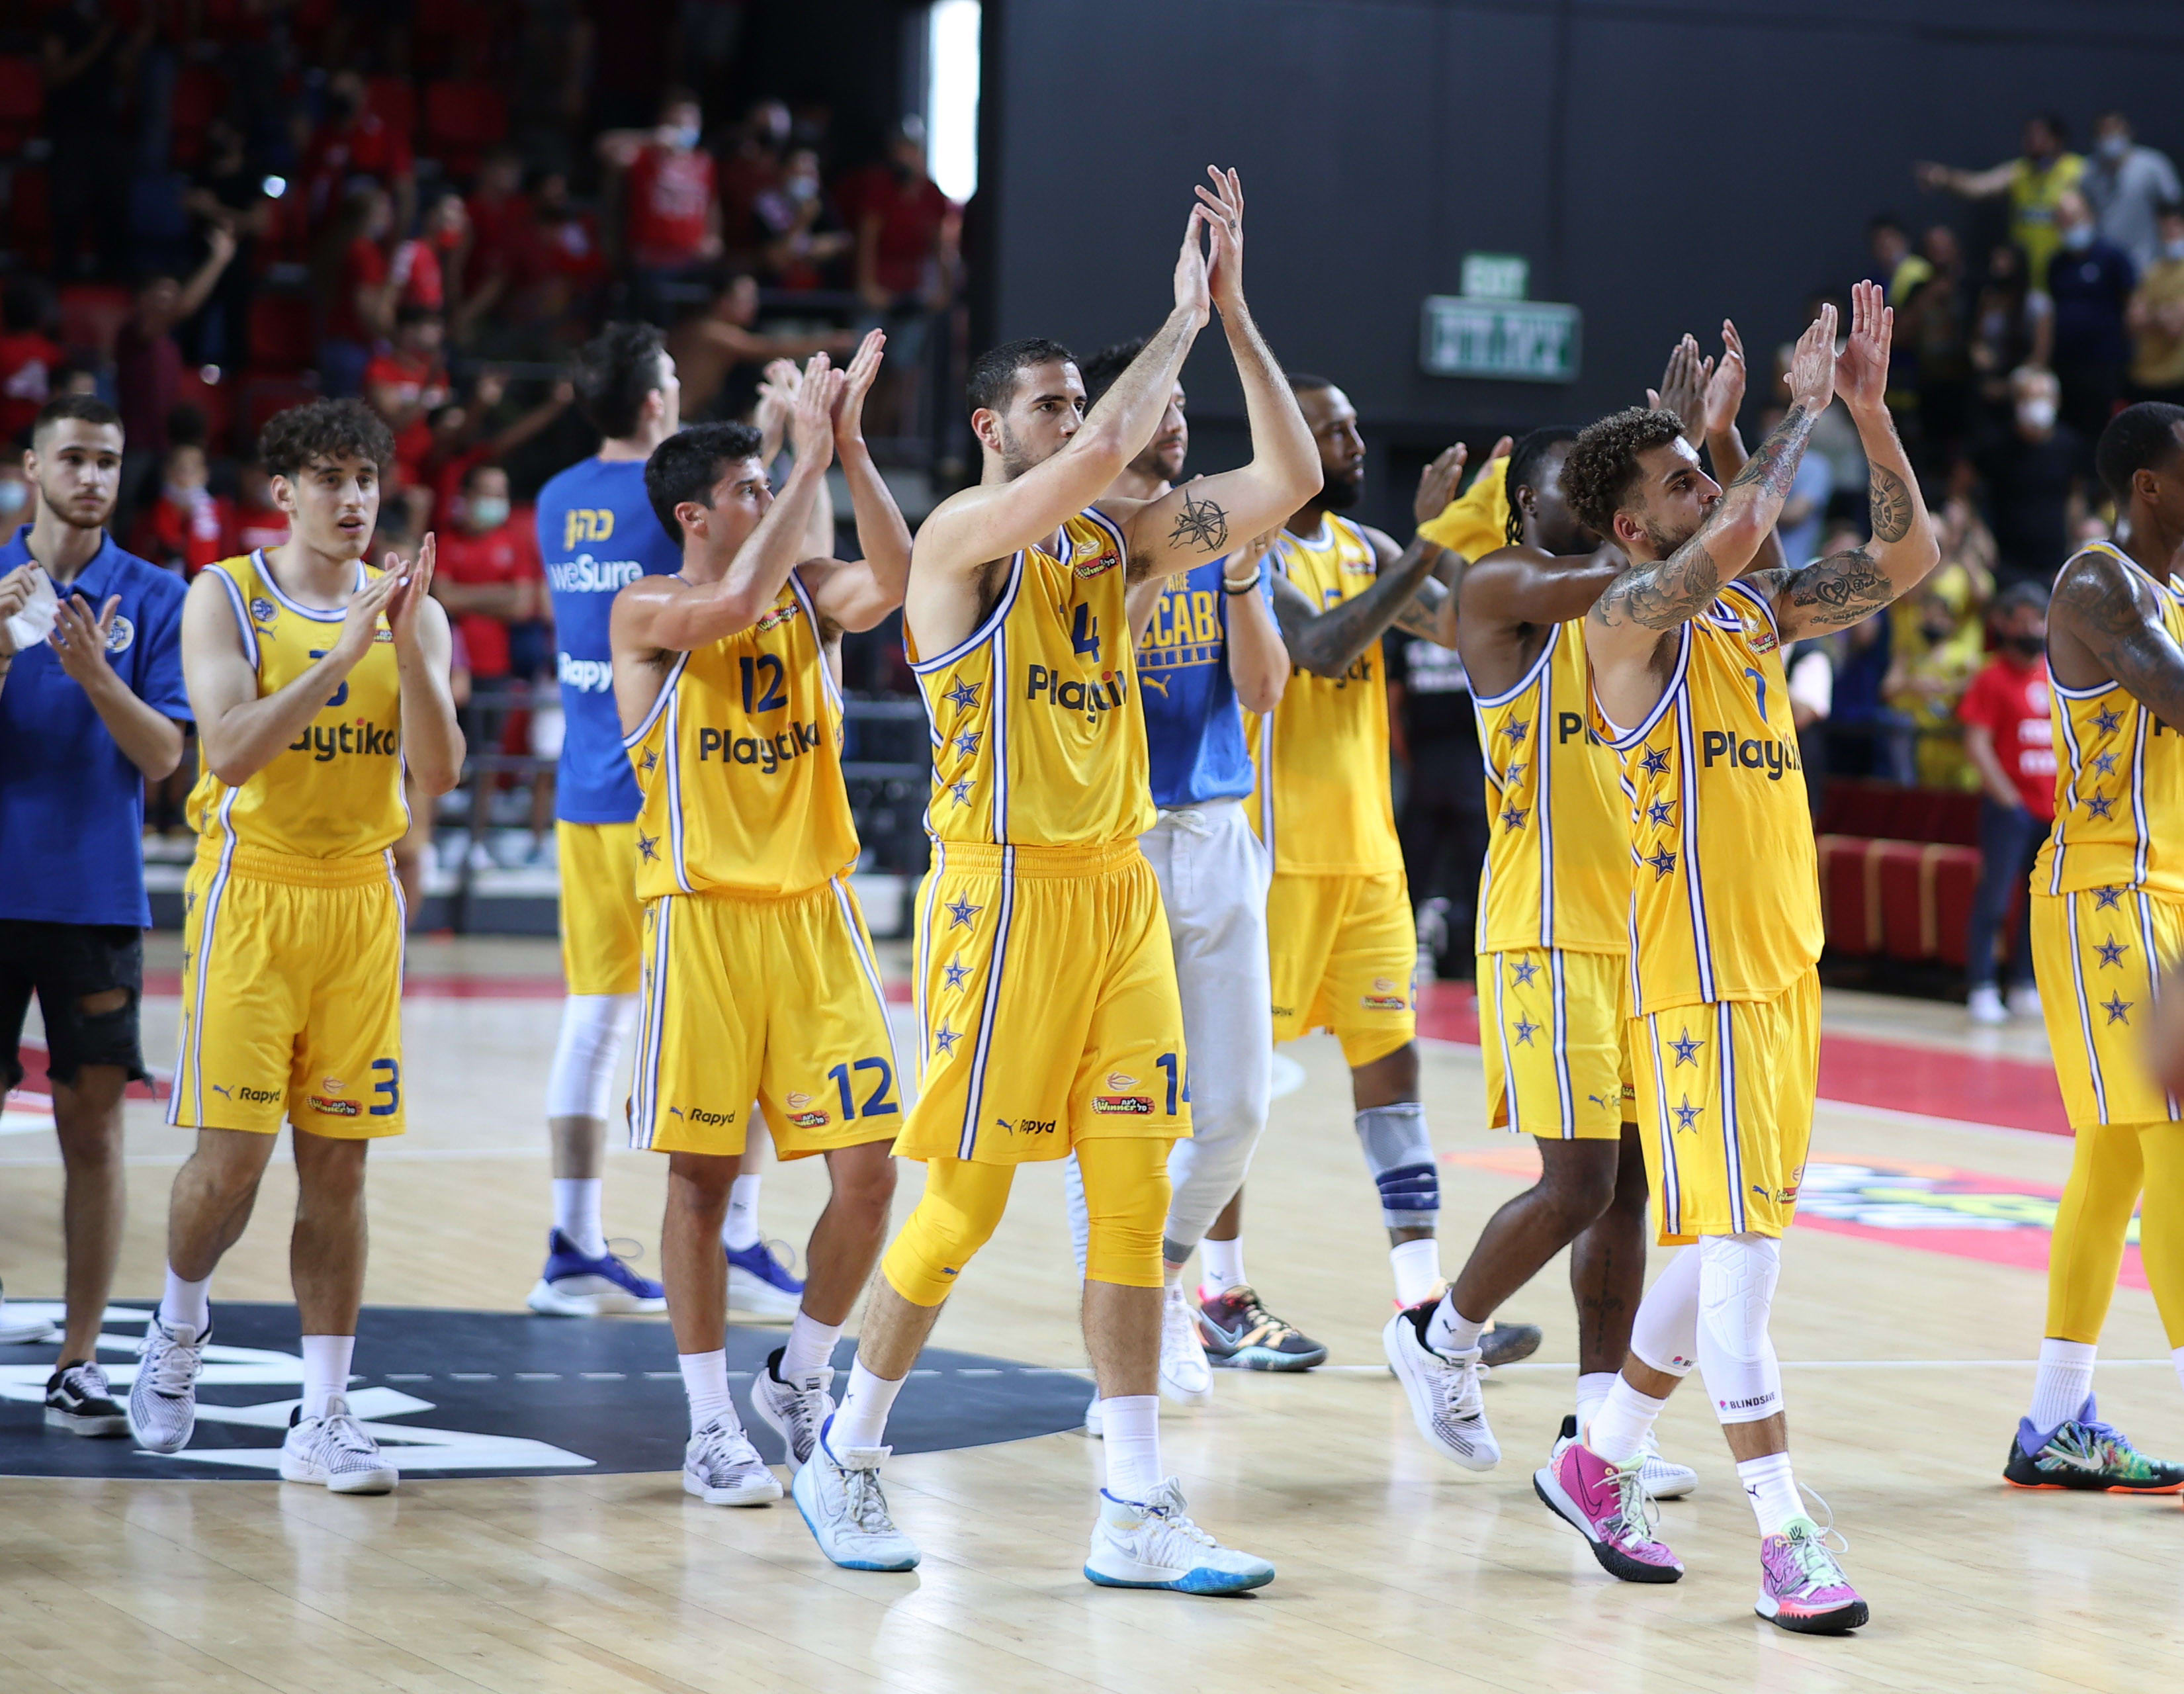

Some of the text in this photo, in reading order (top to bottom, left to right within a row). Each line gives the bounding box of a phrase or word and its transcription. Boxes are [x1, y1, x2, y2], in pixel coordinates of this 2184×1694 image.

[564, 510, 615, 551] כהן
[549, 553, 644, 593] weSure
[739, 652, 788, 714] 12
[240, 1087, 281, 1104] Rapyd
[369, 1057, 400, 1116] 3
[828, 1056, 898, 1121] 12
[689, 1108, 736, 1126] Rapyd
[1098, 1100, 1137, 1111] Winner
[1137, 1103, 1147, 1112] סל
[1729, 1392, 1776, 1409] BLINDSAVE
